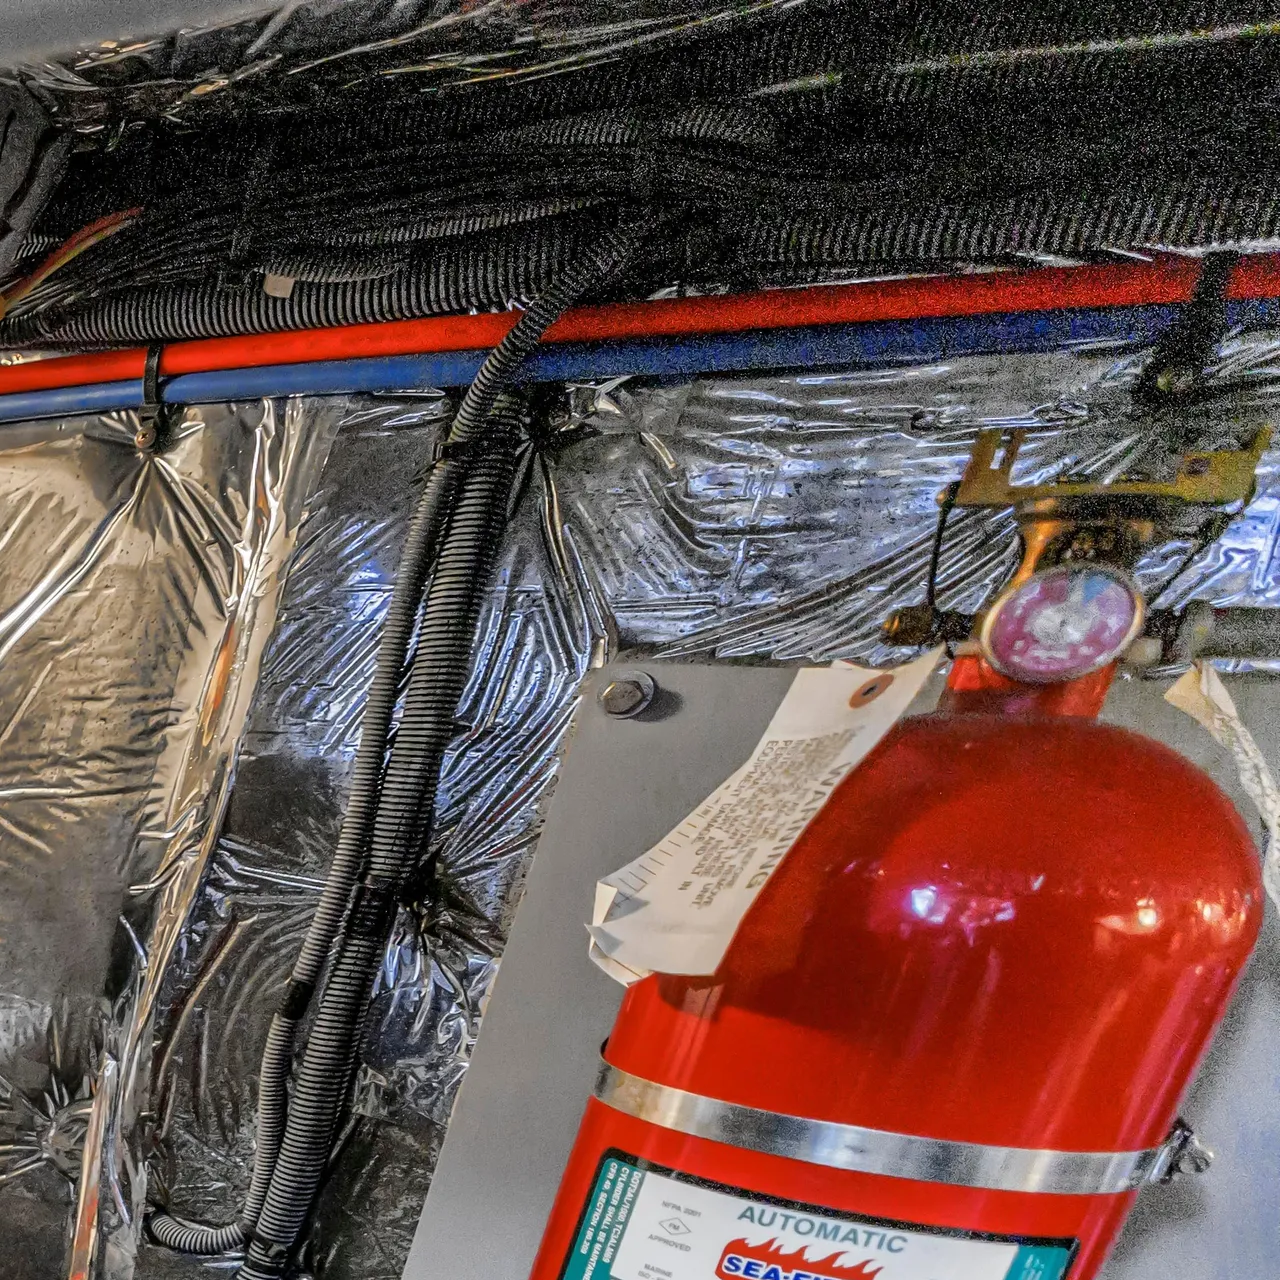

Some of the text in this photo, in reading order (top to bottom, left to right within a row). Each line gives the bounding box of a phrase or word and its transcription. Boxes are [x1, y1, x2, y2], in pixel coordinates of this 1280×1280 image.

[744, 763, 851, 889] WARNING
[608, 1165, 629, 1206] CYLINDER
[588, 1190, 607, 1227] SECTION
[599, 1204, 616, 1231] SHALL
[595, 1229, 607, 1243] BE
[647, 1233, 691, 1252] APPROVED
[738, 1203, 908, 1254] AUTOMATIC
